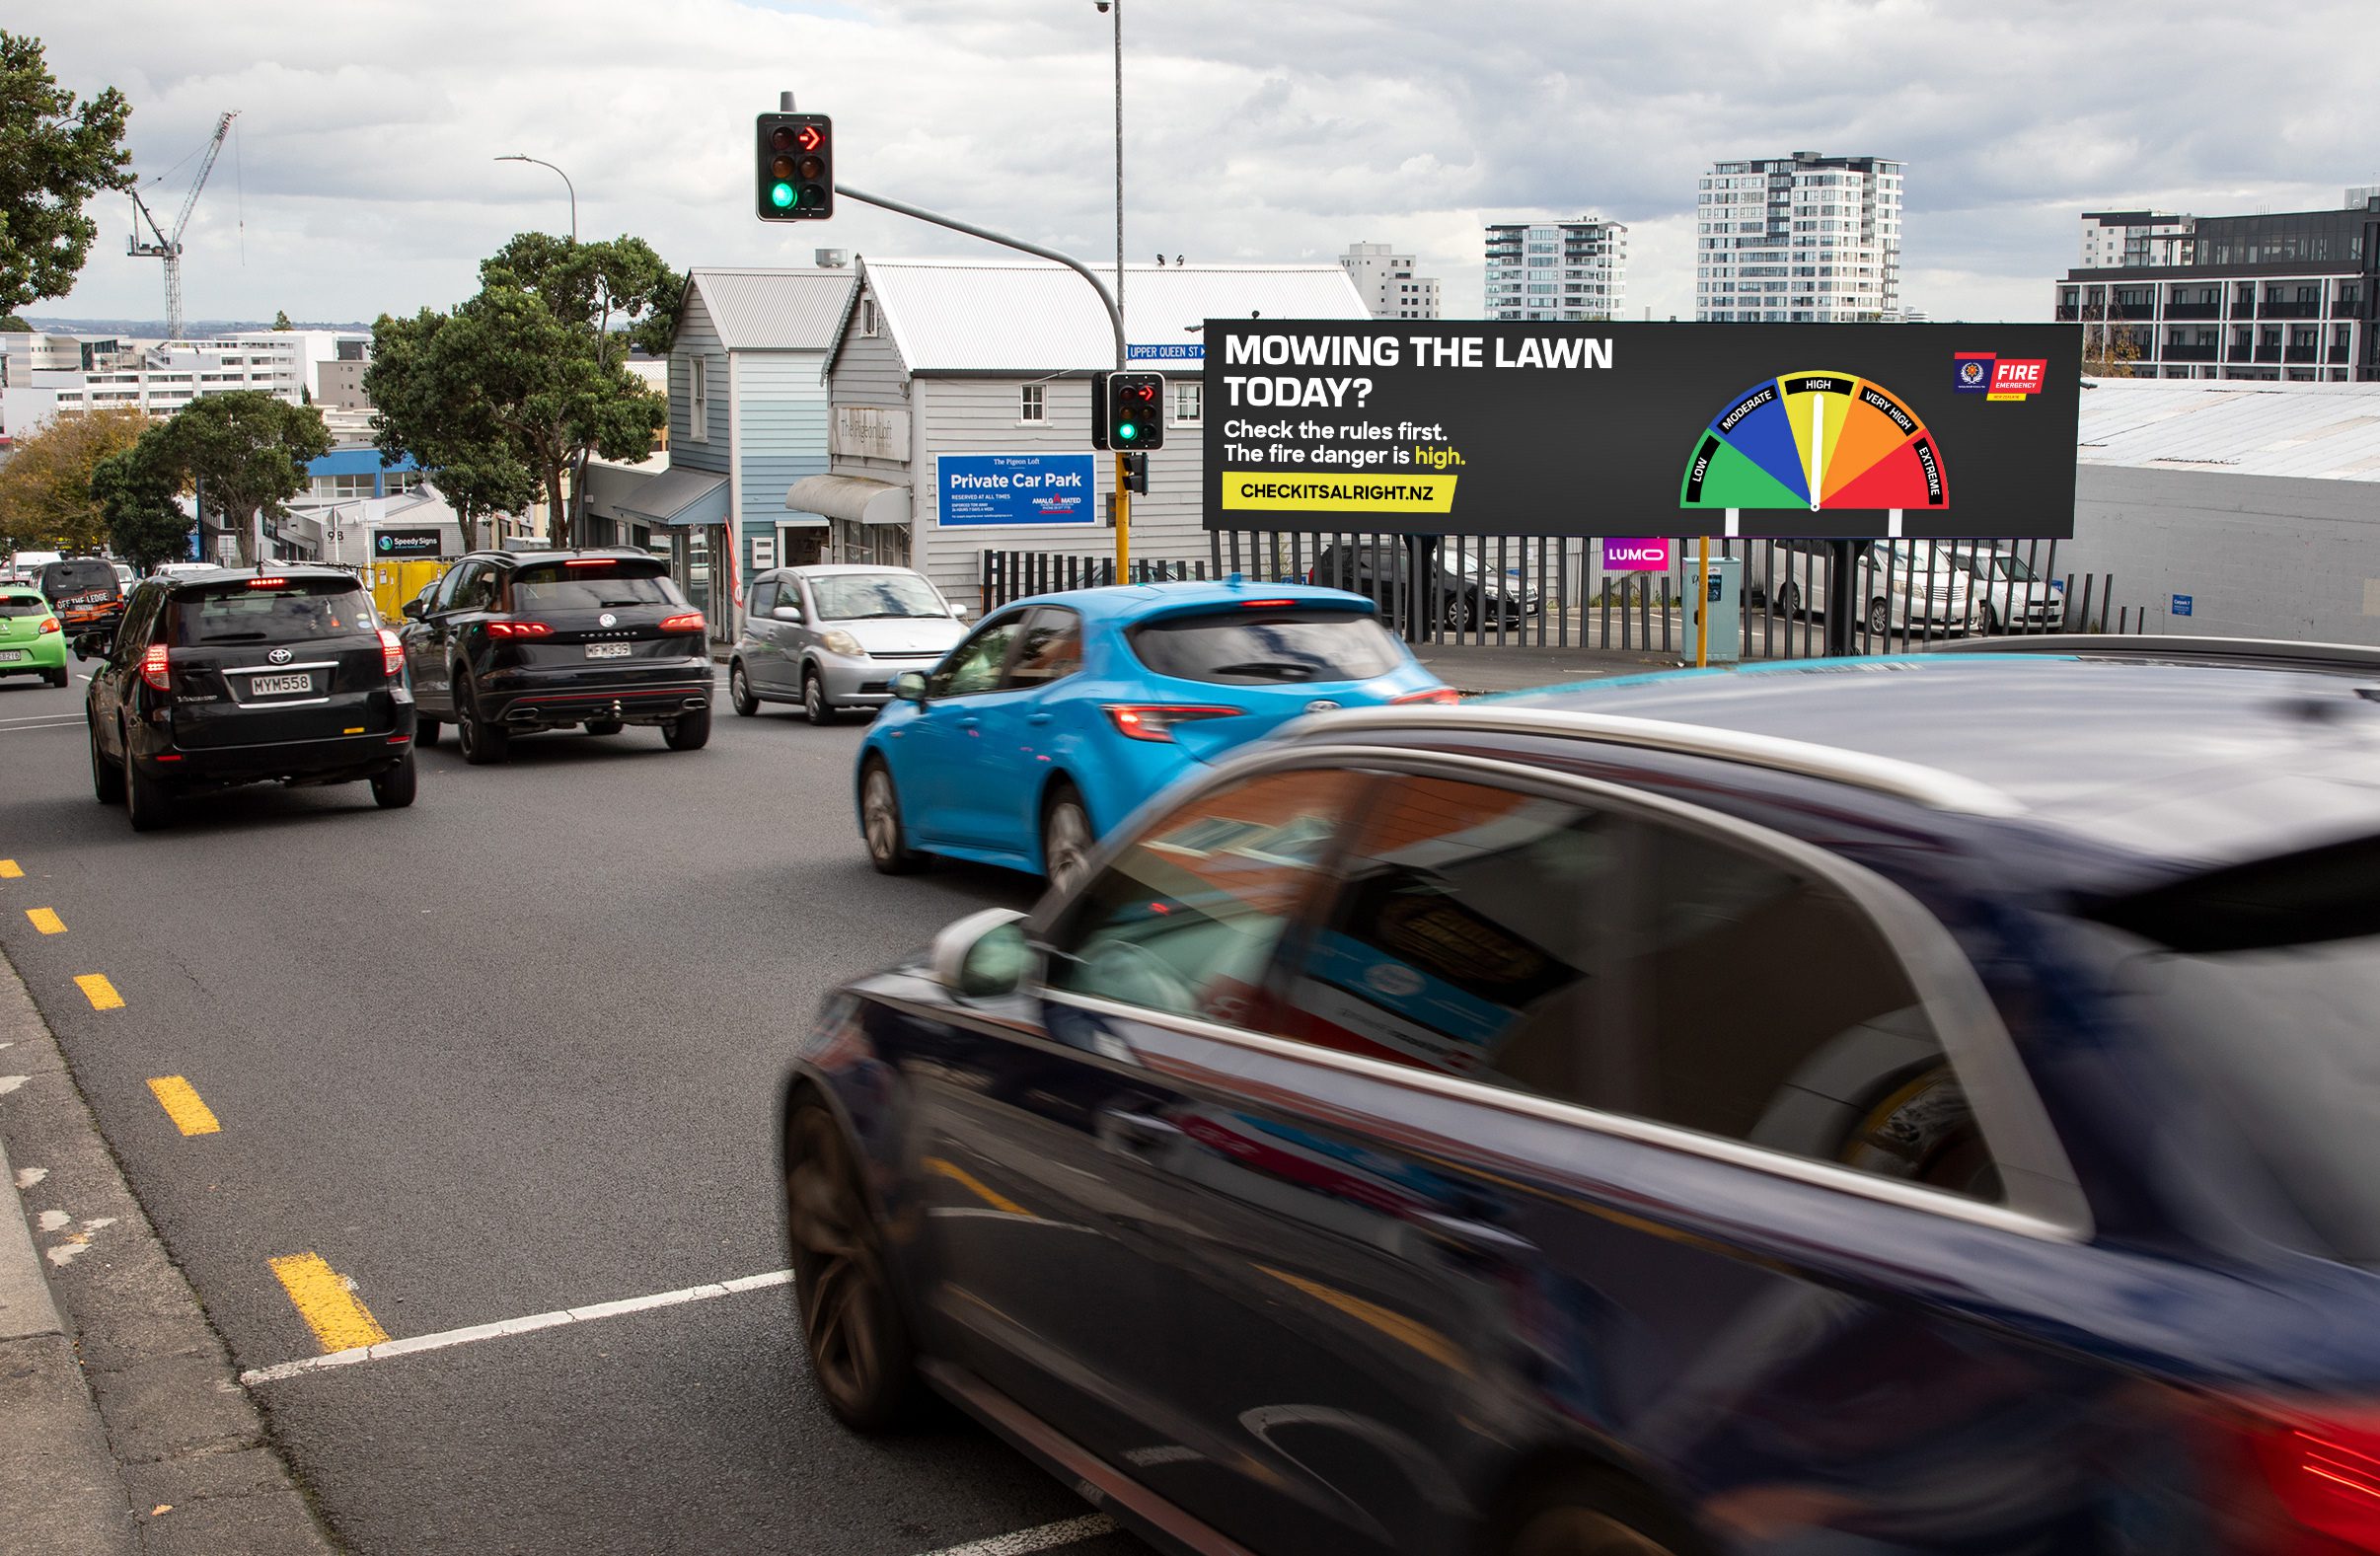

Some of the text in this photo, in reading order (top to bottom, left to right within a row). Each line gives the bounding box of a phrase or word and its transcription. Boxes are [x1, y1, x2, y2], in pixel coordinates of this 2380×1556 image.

[1131, 346, 1199, 357] UPPER QUEEN ST
[1226, 334, 1613, 369] MOWING THE LAWN
[1997, 364, 2041, 381] FIRE
[1224, 376, 1374, 408] TODAY?
[1806, 380, 1831, 390] HIGH
[1722, 390, 1772, 430] MODERATE
[1865, 391, 1912, 430] VERY HIGH
[841, 418, 854, 437] The
[1224, 419, 1448, 441] Check the rules first.
[1006, 458, 1026, 467] Pigeon
[1224, 443, 1466, 470] The fire danger is high.
[1692, 457, 1707, 482] LOW
[1918, 446, 1940, 495] EXTREME
[950, 472, 1082, 488] Private Car Park
[1032, 492, 1081, 504] AMALGAMATED
[1240, 483, 1434, 500] CHECKITSALRIGHT.NZ
[328, 531, 343, 541] 98
[394, 537, 438, 547] Speedy Signs
[1609, 549, 1665, 560] LUMO
[57, 599, 70, 610] OFF
[87, 592, 108, 603] LEDGE
[254, 675, 309, 692] MYM558
